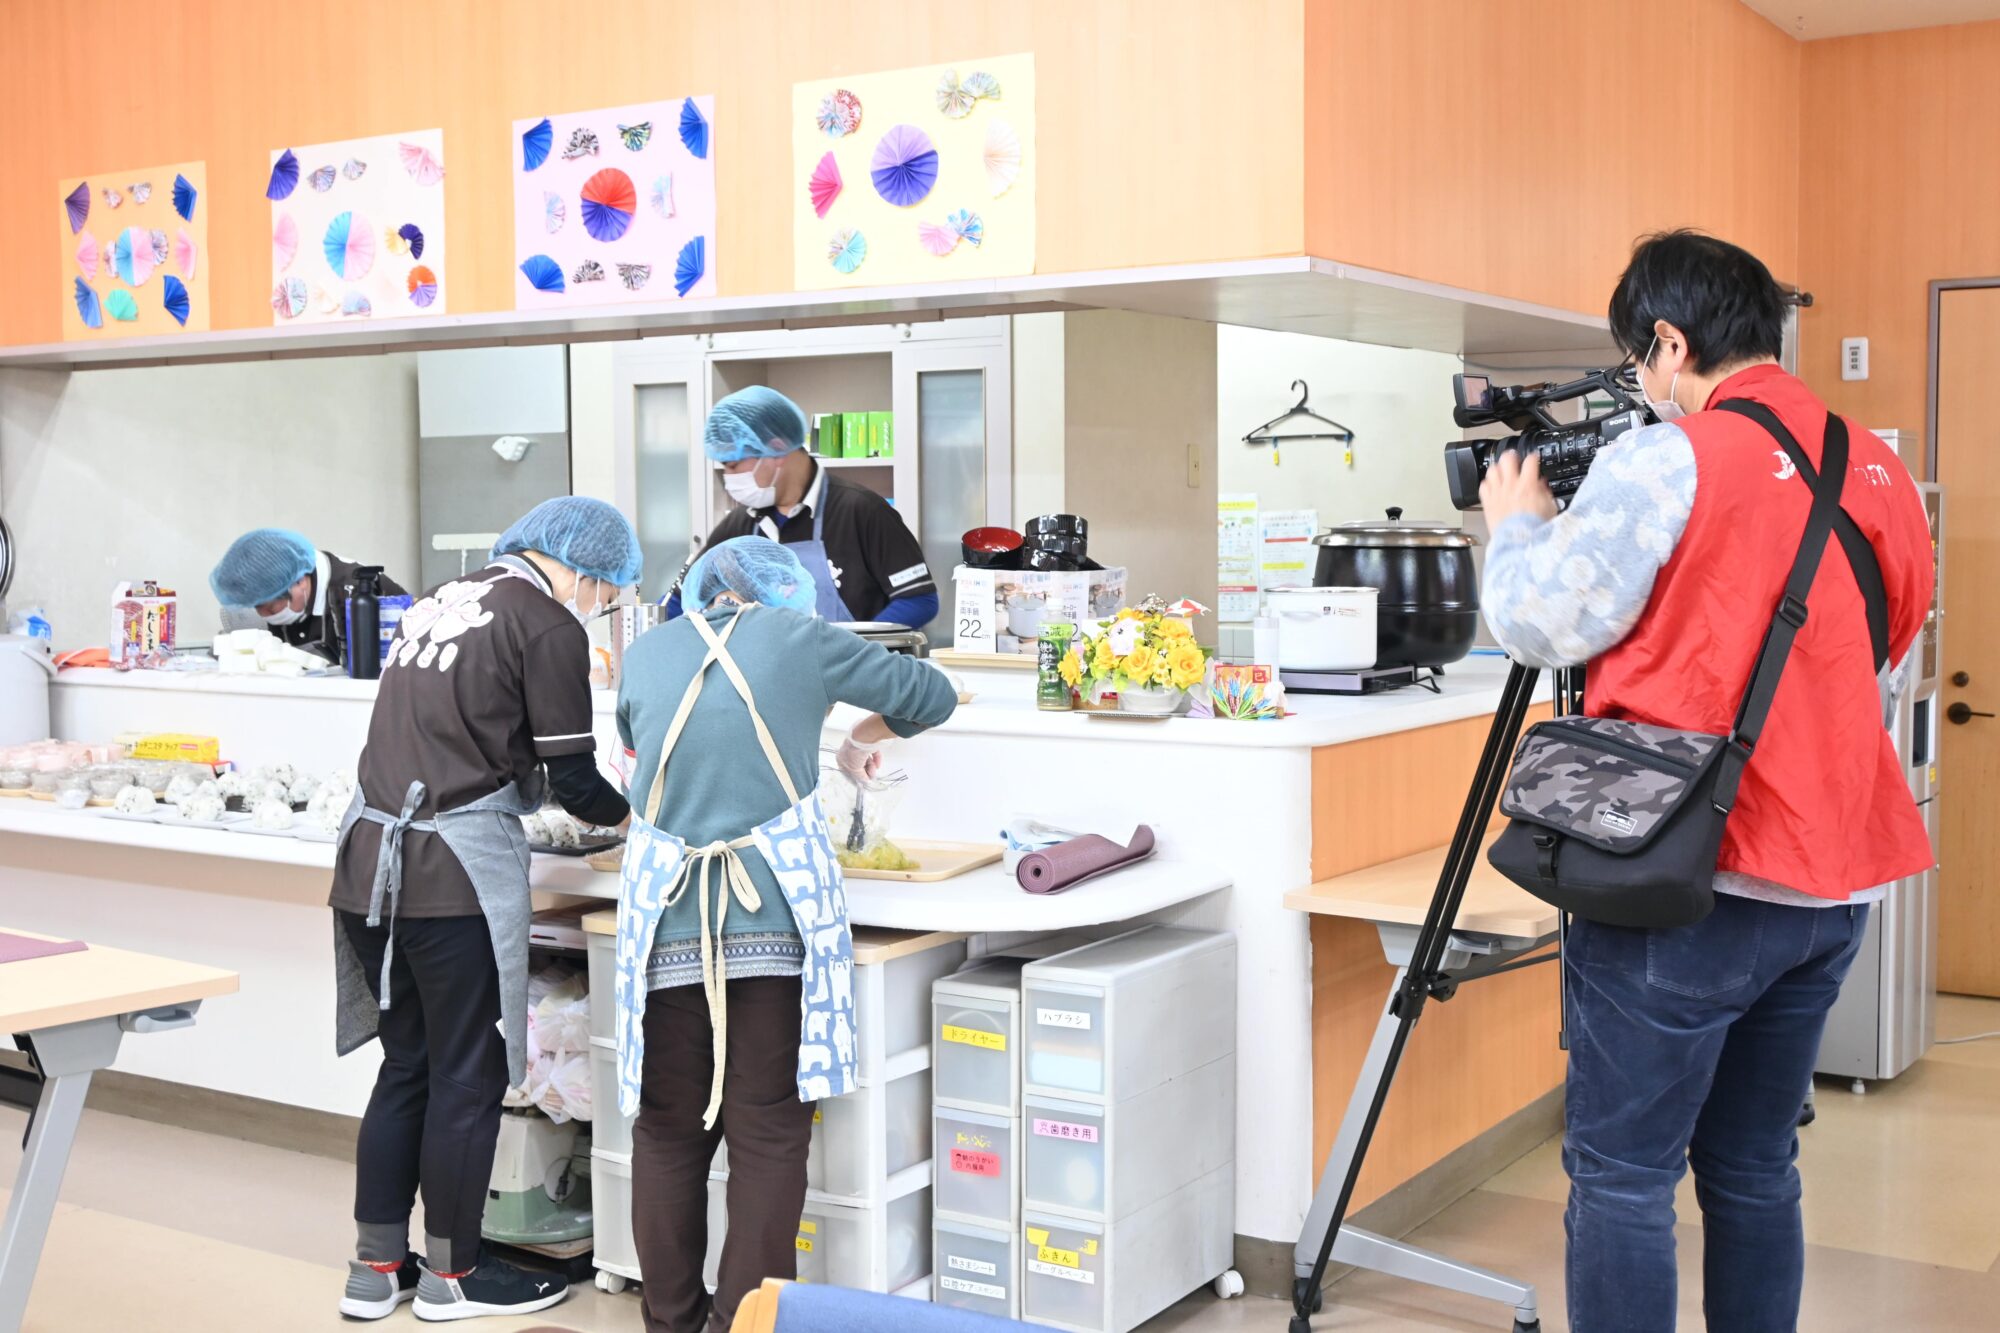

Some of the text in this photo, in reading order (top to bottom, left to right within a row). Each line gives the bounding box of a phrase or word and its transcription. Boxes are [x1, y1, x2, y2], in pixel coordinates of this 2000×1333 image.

[1609, 417, 1629, 426] SONY
[960, 618, 981, 639] 22
[951, 1028, 1001, 1045] ドライヤー
[1039, 1248, 1071, 1264] ふきん
